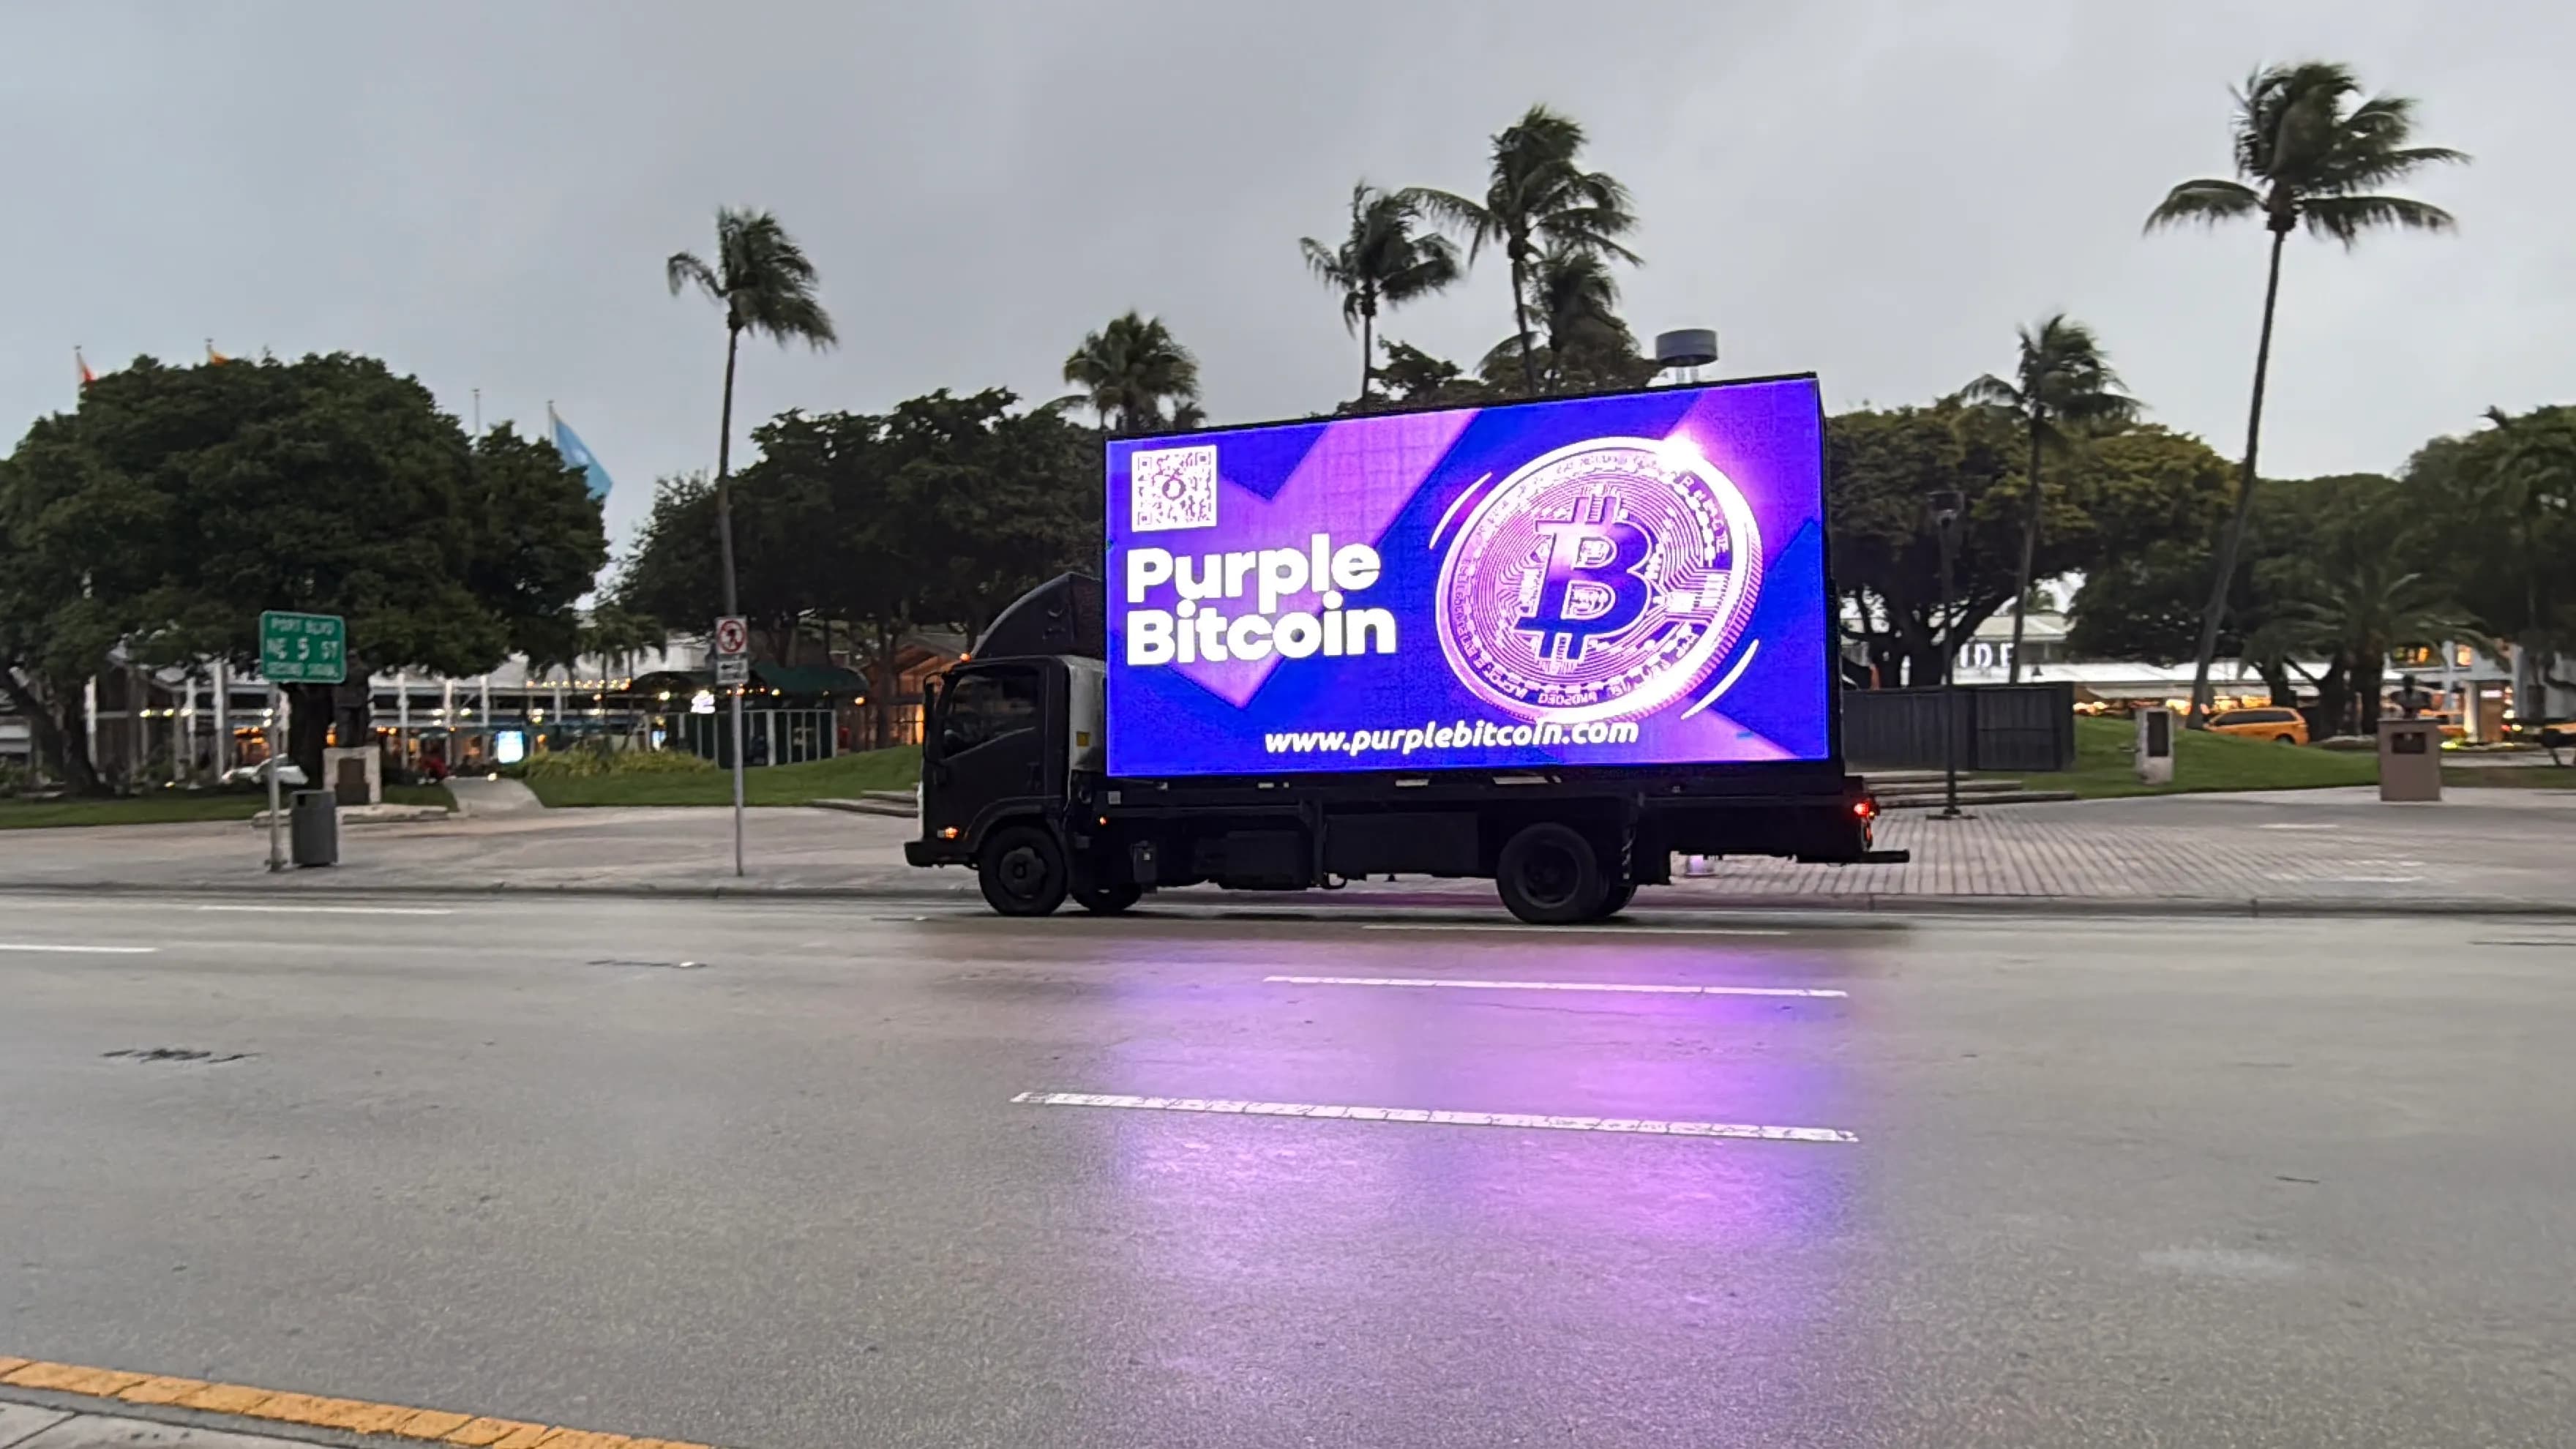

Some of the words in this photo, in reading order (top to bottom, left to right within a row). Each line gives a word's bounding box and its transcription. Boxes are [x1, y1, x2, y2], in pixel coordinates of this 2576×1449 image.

[1127, 533, 1382, 615] Purple
[271, 618, 301, 632] PORT
[1127, 590, 1397, 665] Bitcoin
[266, 637, 288, 659] NE
[296, 636, 310, 661] 5
[320, 640, 340, 661] ST
[1264, 719, 1639, 757] www.purplebitcoin.com
